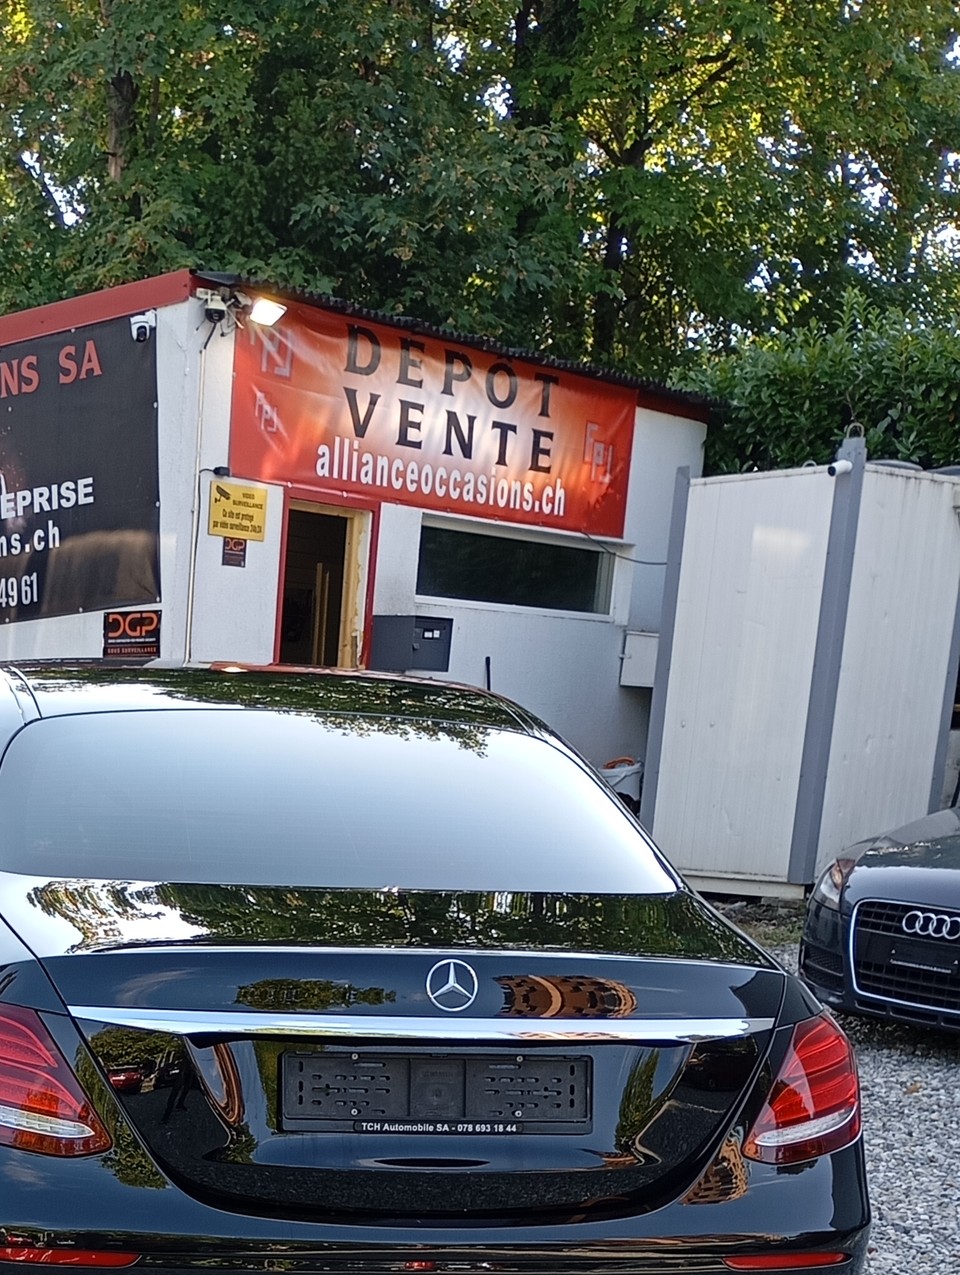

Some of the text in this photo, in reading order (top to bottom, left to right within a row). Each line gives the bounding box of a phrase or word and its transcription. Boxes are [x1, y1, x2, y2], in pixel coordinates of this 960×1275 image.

[58, 339, 103, 385] SA
[343, 324, 560, 418] DEPÔT
[343, 386, 556, 474] VENTE
[315, 436, 566, 517] allianceoccasions.ch
[361, 1122, 381, 1131] TCH
[383, 1122, 434, 1132] Automobile
[436, 1123, 450, 1132] SA
[457, 1124, 474, 1132] 078
[475, 1124, 491, 1133] 693
[493, 1124, 504, 1133] 18
[506, 1124, 517, 1133] 44
